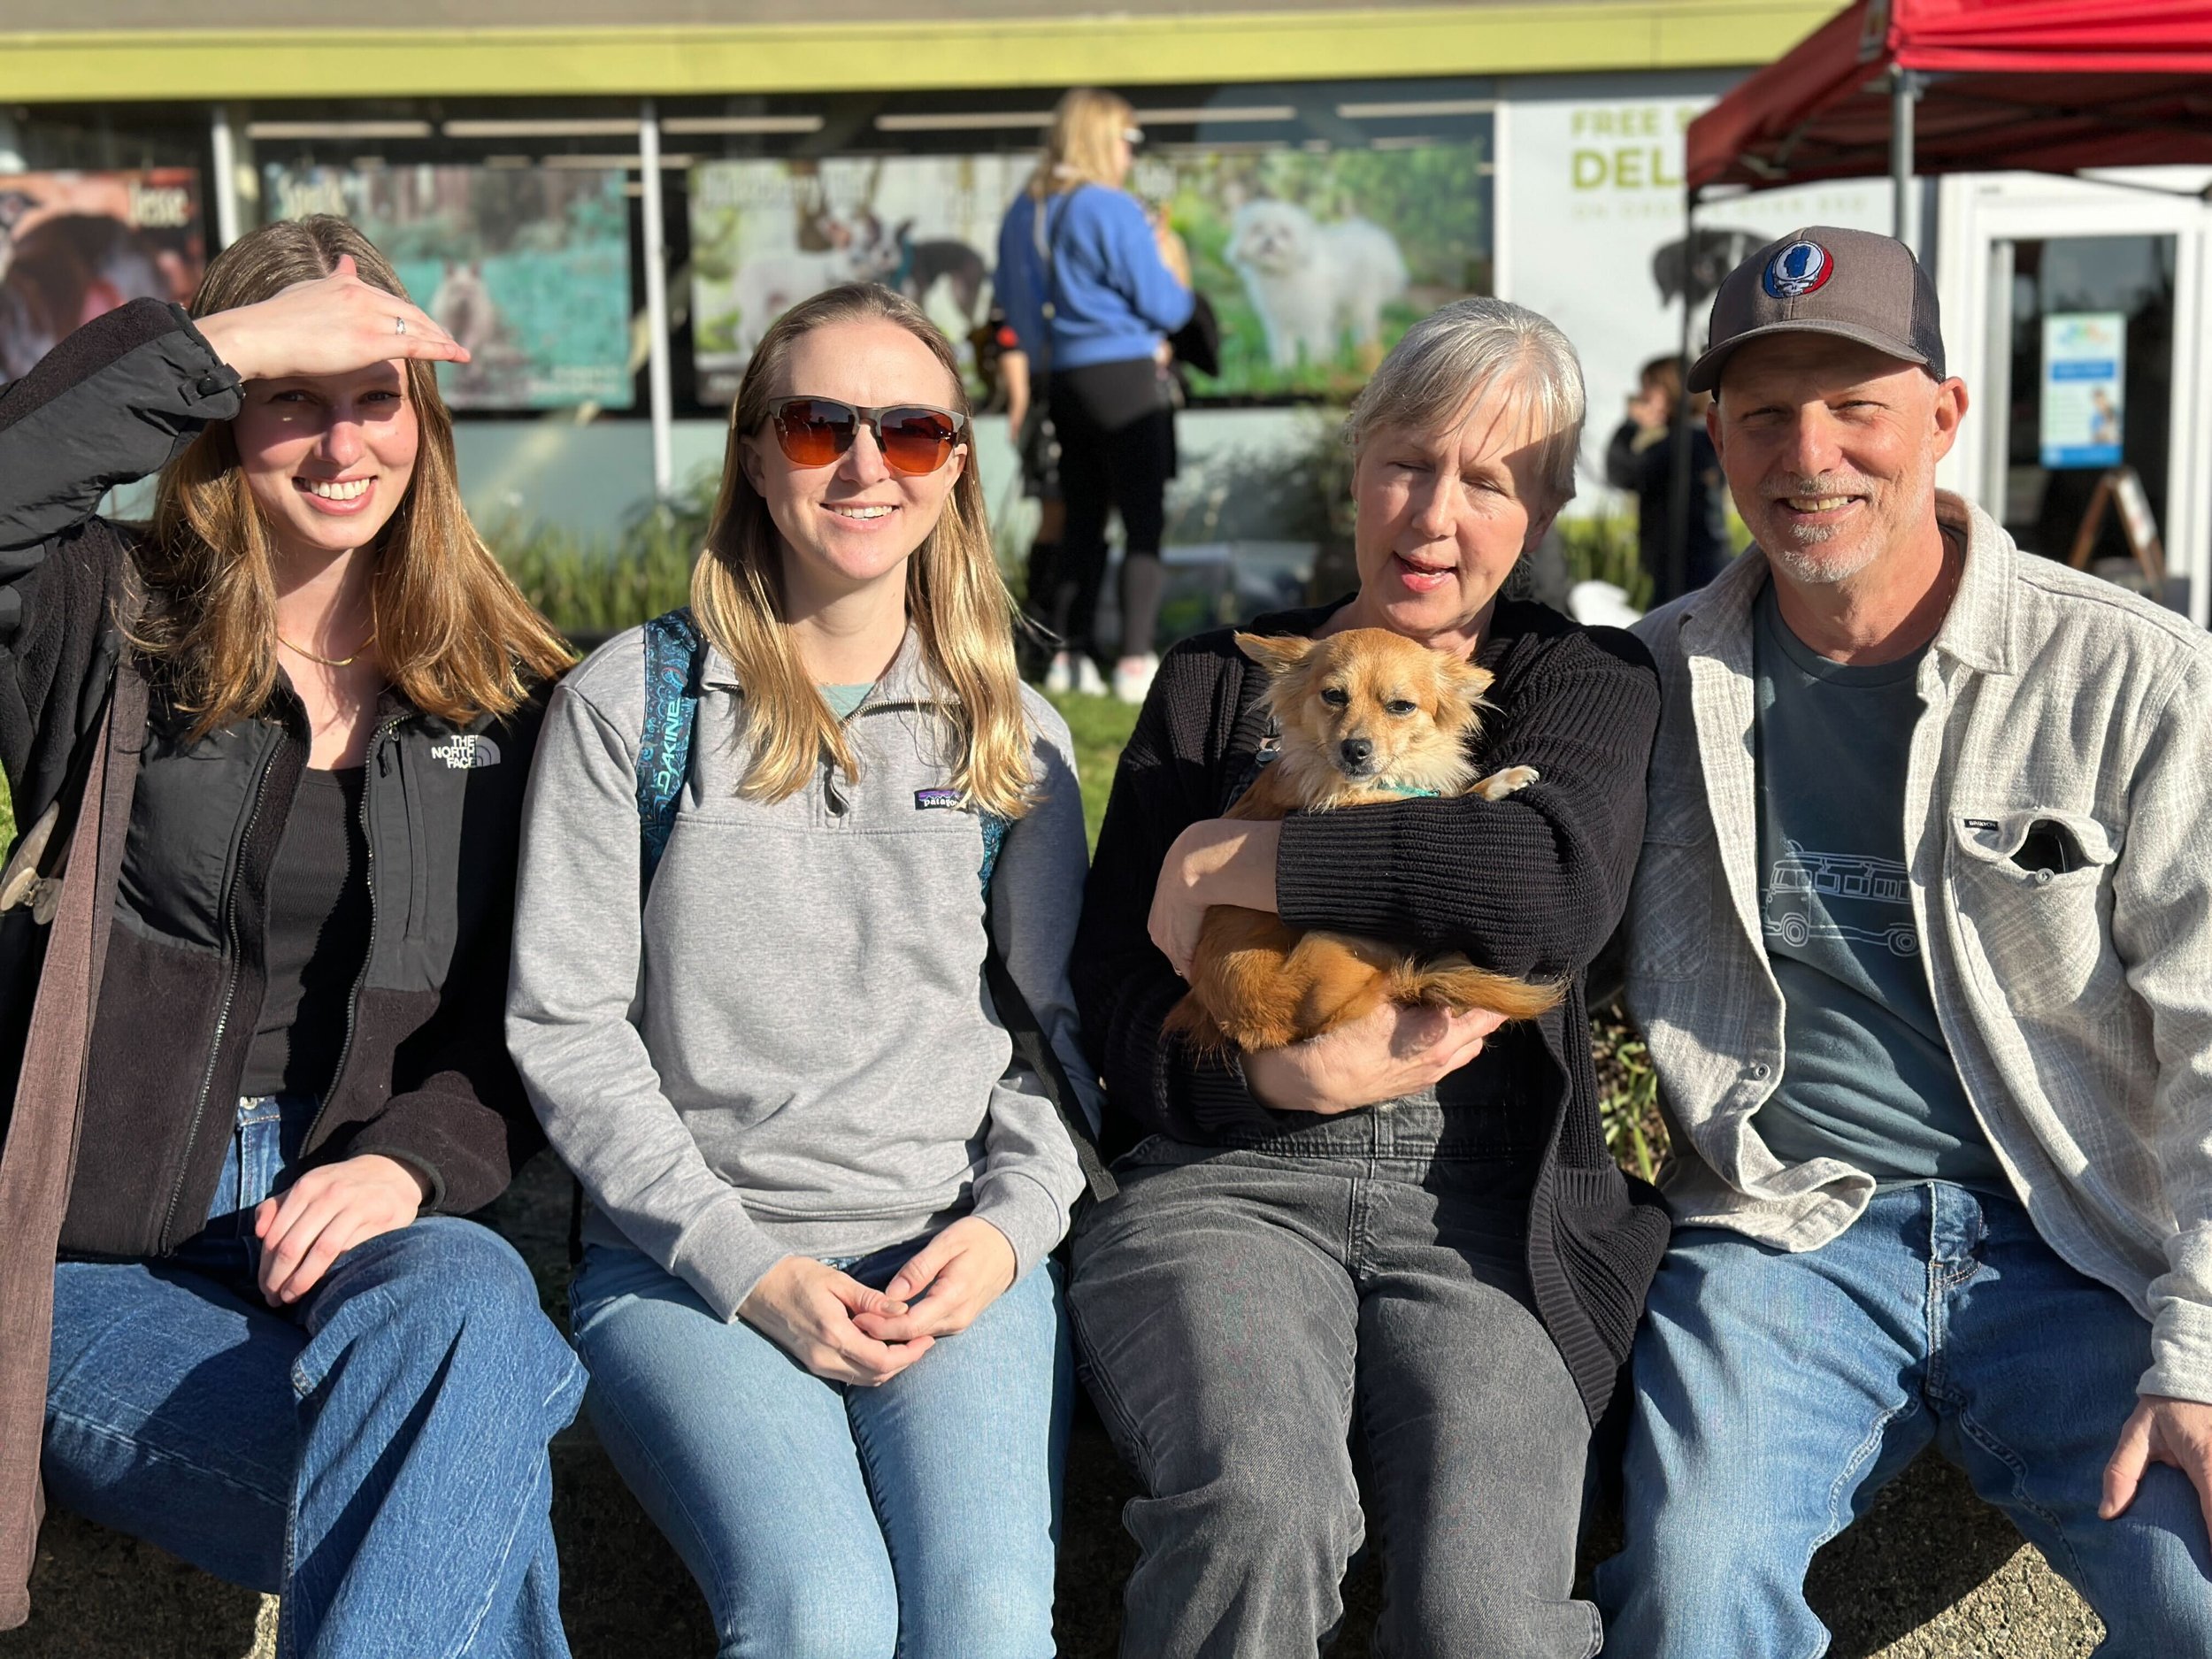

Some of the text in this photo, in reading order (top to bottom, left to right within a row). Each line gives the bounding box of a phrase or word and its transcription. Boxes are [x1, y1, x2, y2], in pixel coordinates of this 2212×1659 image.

[1571, 107, 1660, 138] FREE
[1571, 147, 1683, 190] DEL
[450, 734, 476, 747] THE
[657, 696, 681, 795] DAKINE
[430, 746, 475, 759] NORTH
[446, 757, 477, 769] FACE
